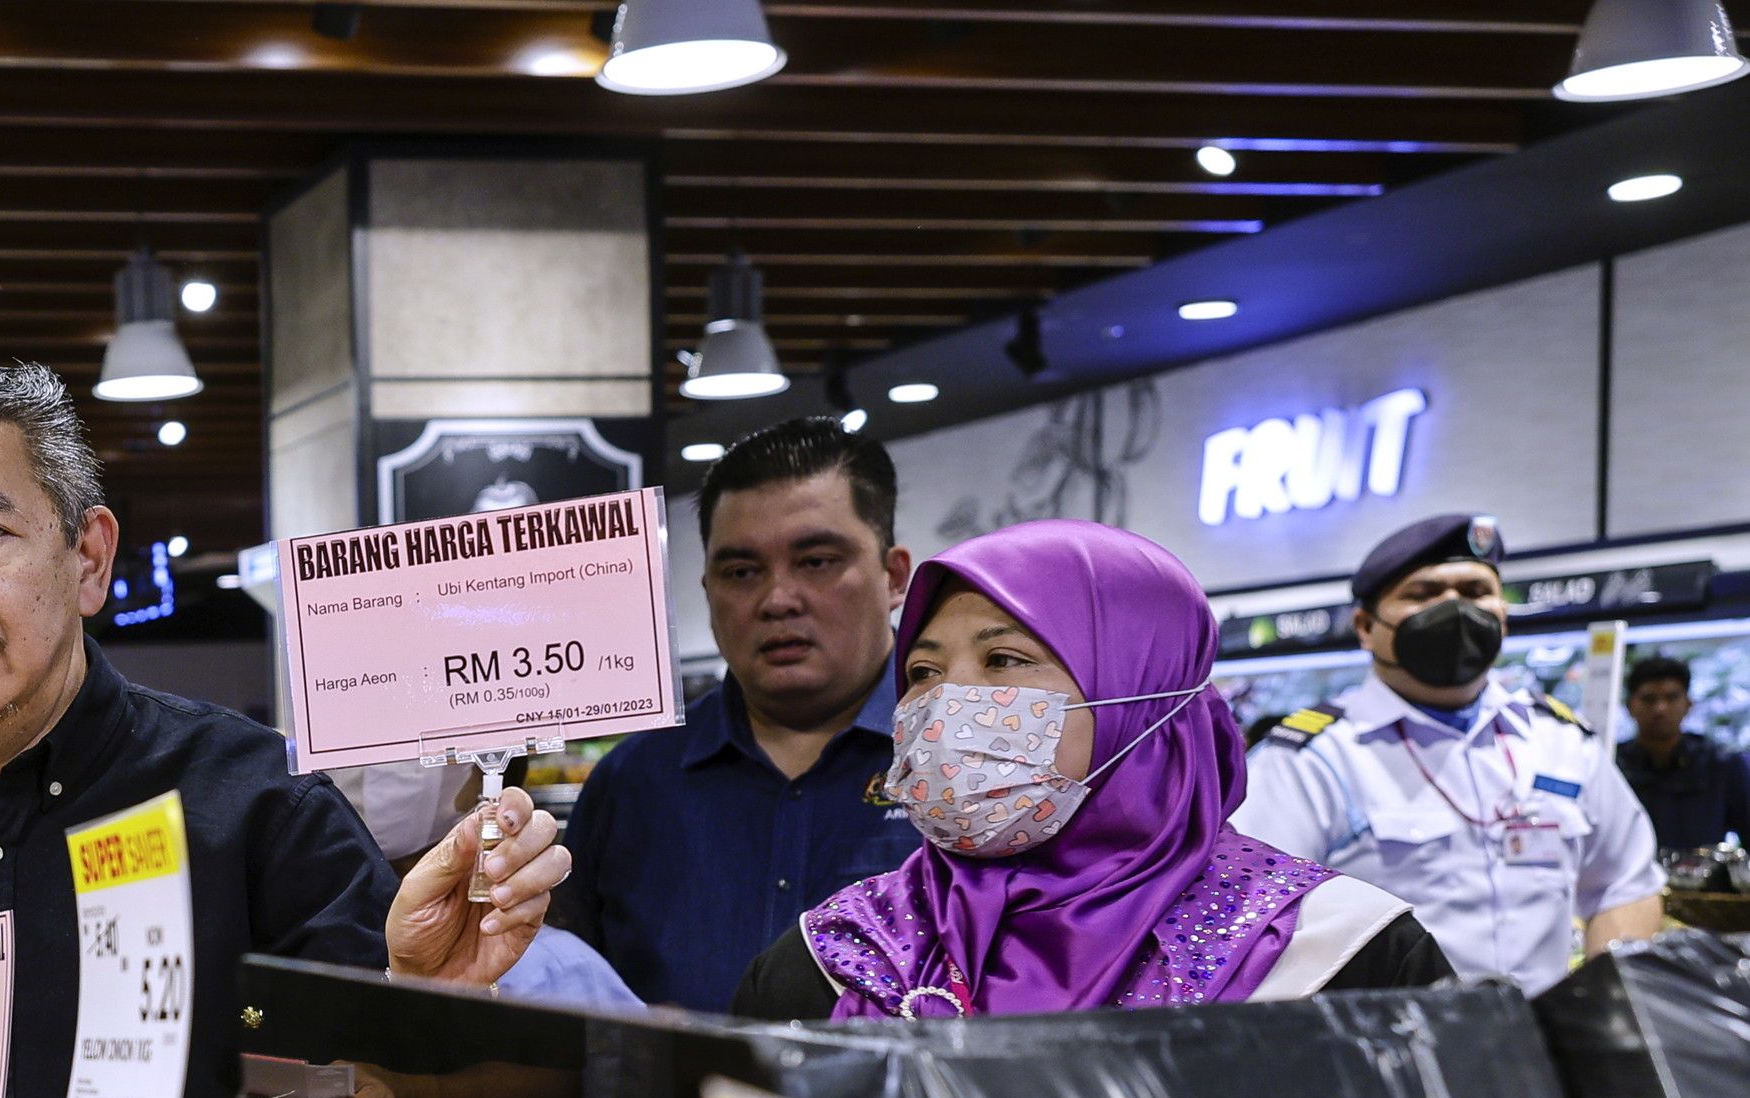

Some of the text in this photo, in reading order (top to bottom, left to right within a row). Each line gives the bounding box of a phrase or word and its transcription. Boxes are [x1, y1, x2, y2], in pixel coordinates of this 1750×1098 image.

[1198, 387, 1427, 526] FRUIT
[297, 498, 639, 581] BARANG HARGA TERKAWAL
[437, 558, 634, 597] Ubi Kentang Import (China)
[307, 602, 349, 617] Nama
[353, 594, 403, 610] Barang
[315, 676, 357, 691] Harga
[361, 672, 397, 686] Aeon
[444, 640, 635, 687] RM 3.50 /1kg
[449, 683, 550, 709] (RM 0.35/100g)
[516, 698, 653, 724] CNY 15/01-29/01/2023
[79, 834, 126, 884] SUPER
